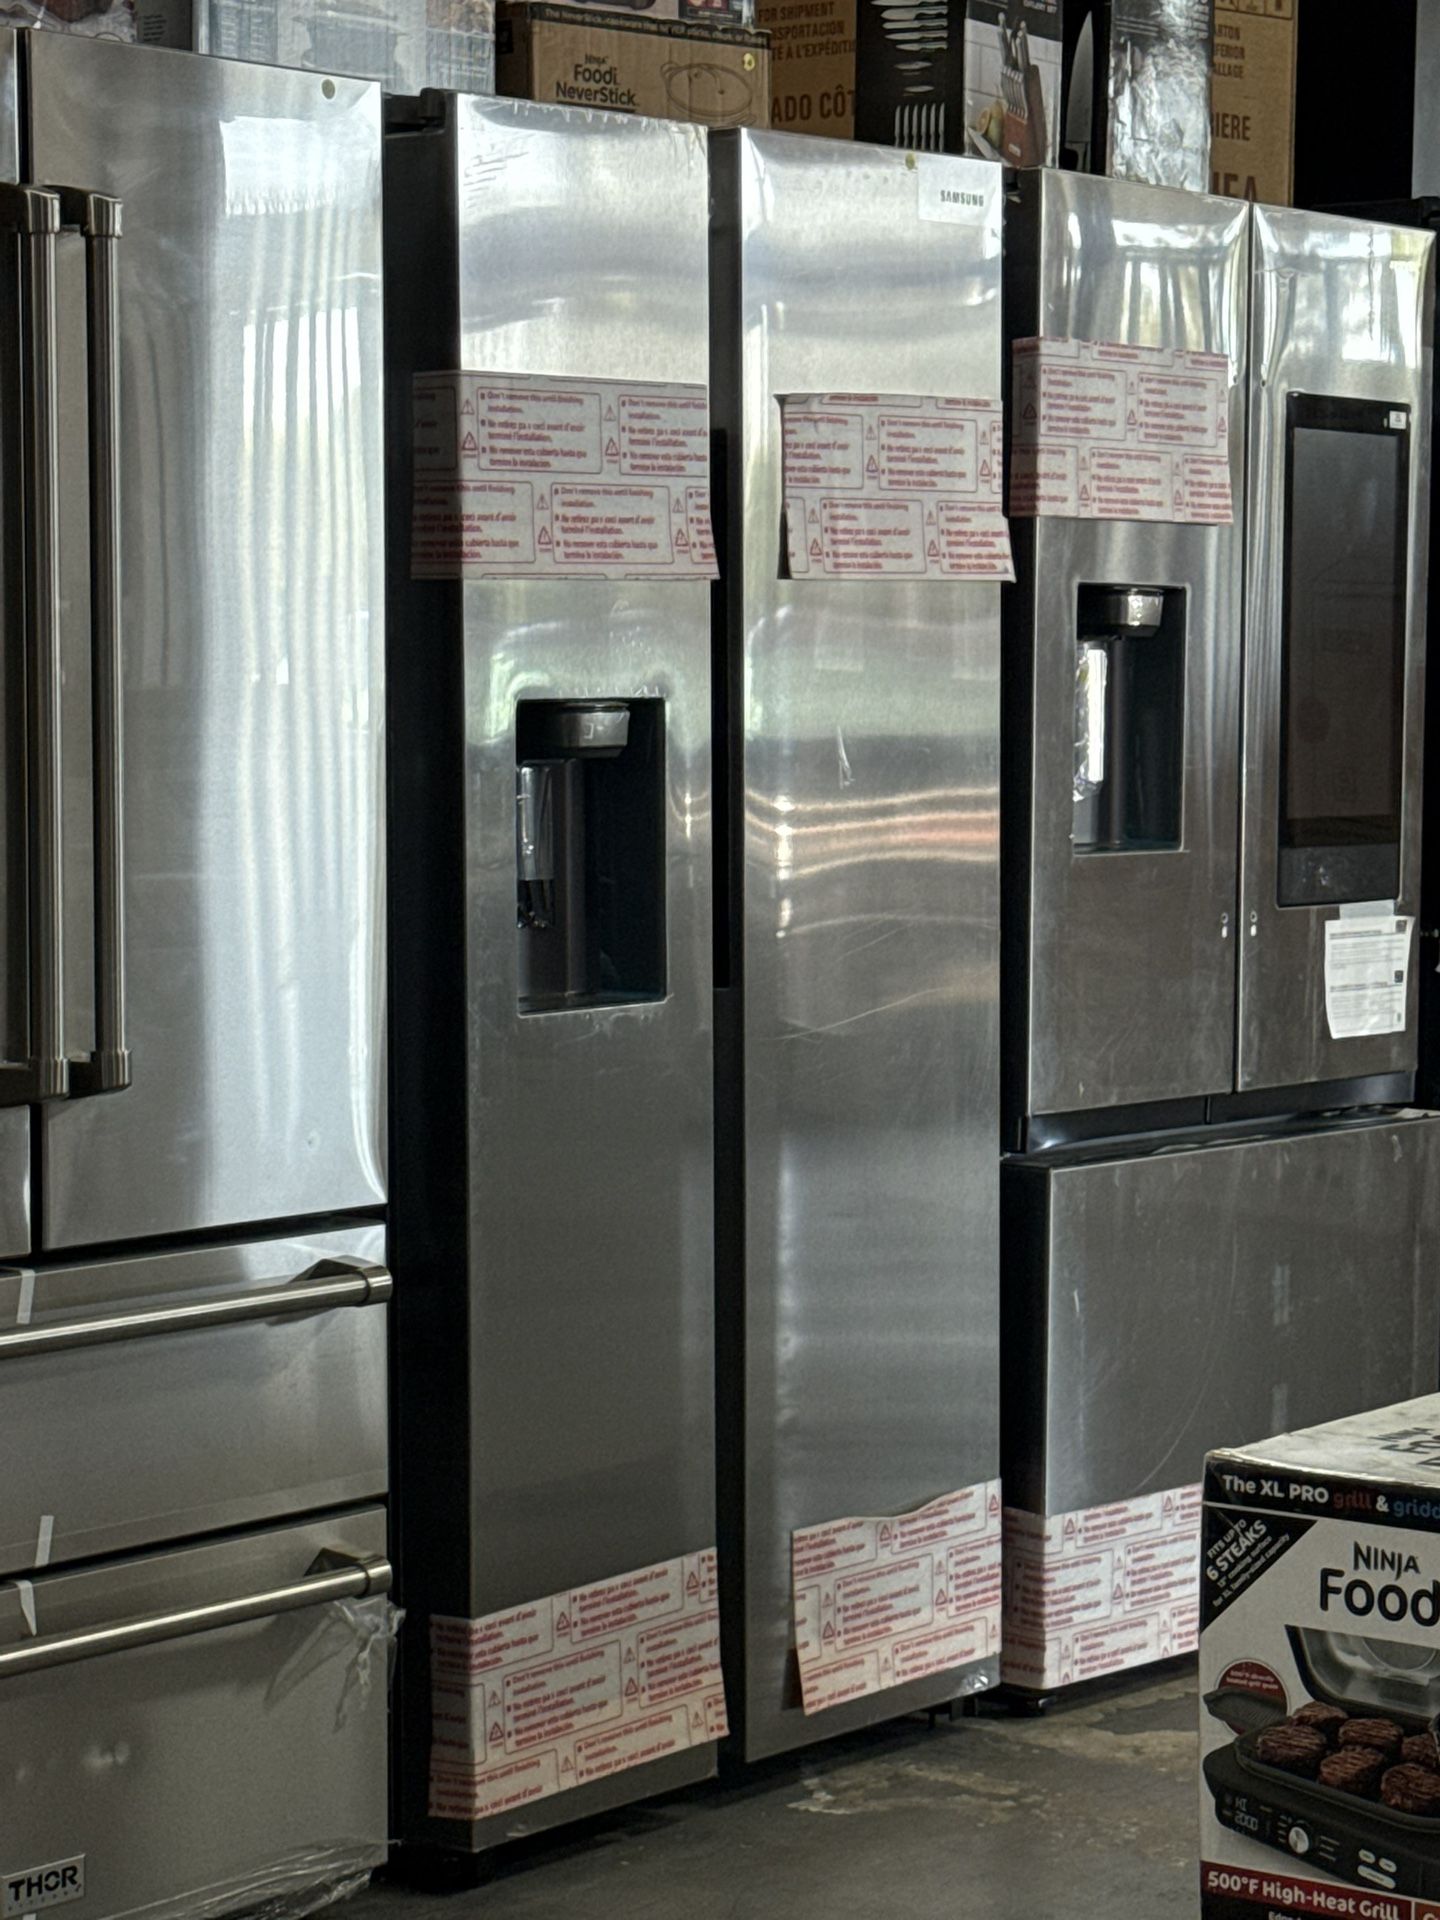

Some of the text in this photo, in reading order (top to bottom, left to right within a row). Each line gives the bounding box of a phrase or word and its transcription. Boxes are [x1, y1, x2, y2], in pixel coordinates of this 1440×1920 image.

[781, 2, 834, 20] SHIPMENT
[574, 64, 618, 85] Foodi
[556, 81, 637, 106] NeverStick
[940, 190, 984, 207] SAMSUNG
[1222, 1475, 1256, 1494] The
[1260, 1479, 1285, 1498] XL
[1289, 1483, 1329, 1504] PRO
[1333, 1490, 1372, 1509] grill
[1376, 1495, 1389, 1512] &
[1206, 1565, 1219, 1581] 6
[1215, 1519, 1267, 1572] STEAKS
[1353, 1540, 1421, 1581] NINJA
[1320, 1567, 1440, 1627] Food
[8, 1865, 78, 1901] THOR
[1207, 1870, 1399, 1920] 500°F High-Heat Grill
